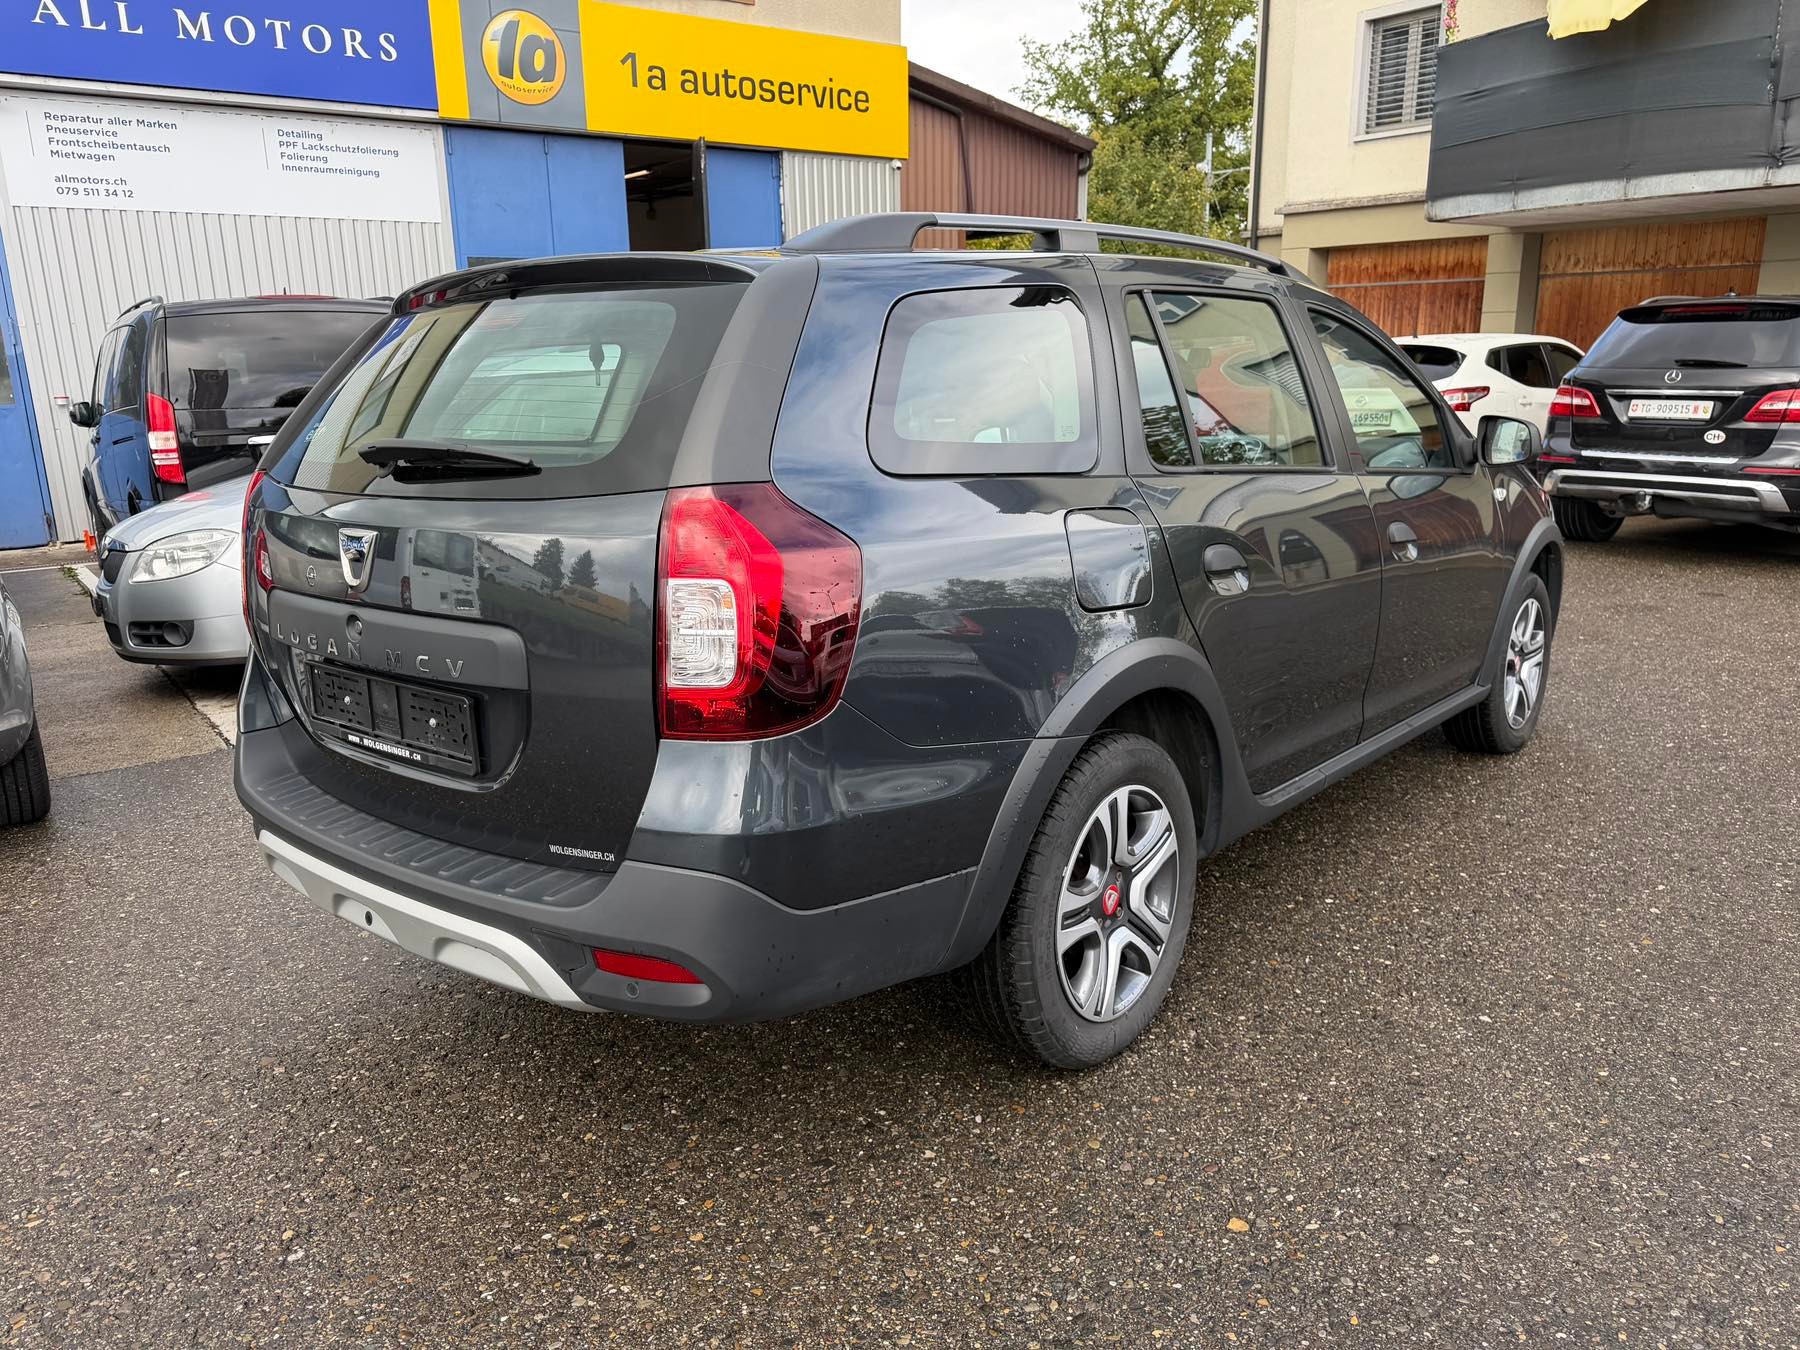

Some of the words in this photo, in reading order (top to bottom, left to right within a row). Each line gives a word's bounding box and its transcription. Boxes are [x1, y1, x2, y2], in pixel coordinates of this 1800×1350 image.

[31, 0, 144, 35] ALL
[172, 8, 398, 62] MOTORS
[490, 19, 557, 83] 1a
[620, 52, 666, 91] 1a
[680, 68, 870, 113] autoservice
[43, 111, 103, 125] Reparatur
[107, 117, 133, 127] aller
[136, 119, 177, 130] Marken
[46, 124, 118, 138] Pneuservice
[277, 129, 323, 142] Detailing
[48, 137, 171, 153] Frontscheibentausch
[279, 140, 298, 150] PPF
[301, 142, 399, 158] Lackschutzfolierung
[50, 149, 116, 162] Mietwagen
[280, 152, 328, 163] Folierung
[281, 163, 380, 178] Innenraumreinigung
[54, 174, 128, 186] allmotors.ch
[56, 186, 79, 196] 079
[83, 187, 101, 197] 511
[103, 188, 119, 198] 34
[121, 189, 134, 198] 12
[277, 623, 361, 662] LOGAN
[385, 649, 464, 679] MCV
[548, 843, 615, 862] WOLGENSINGER.CH
